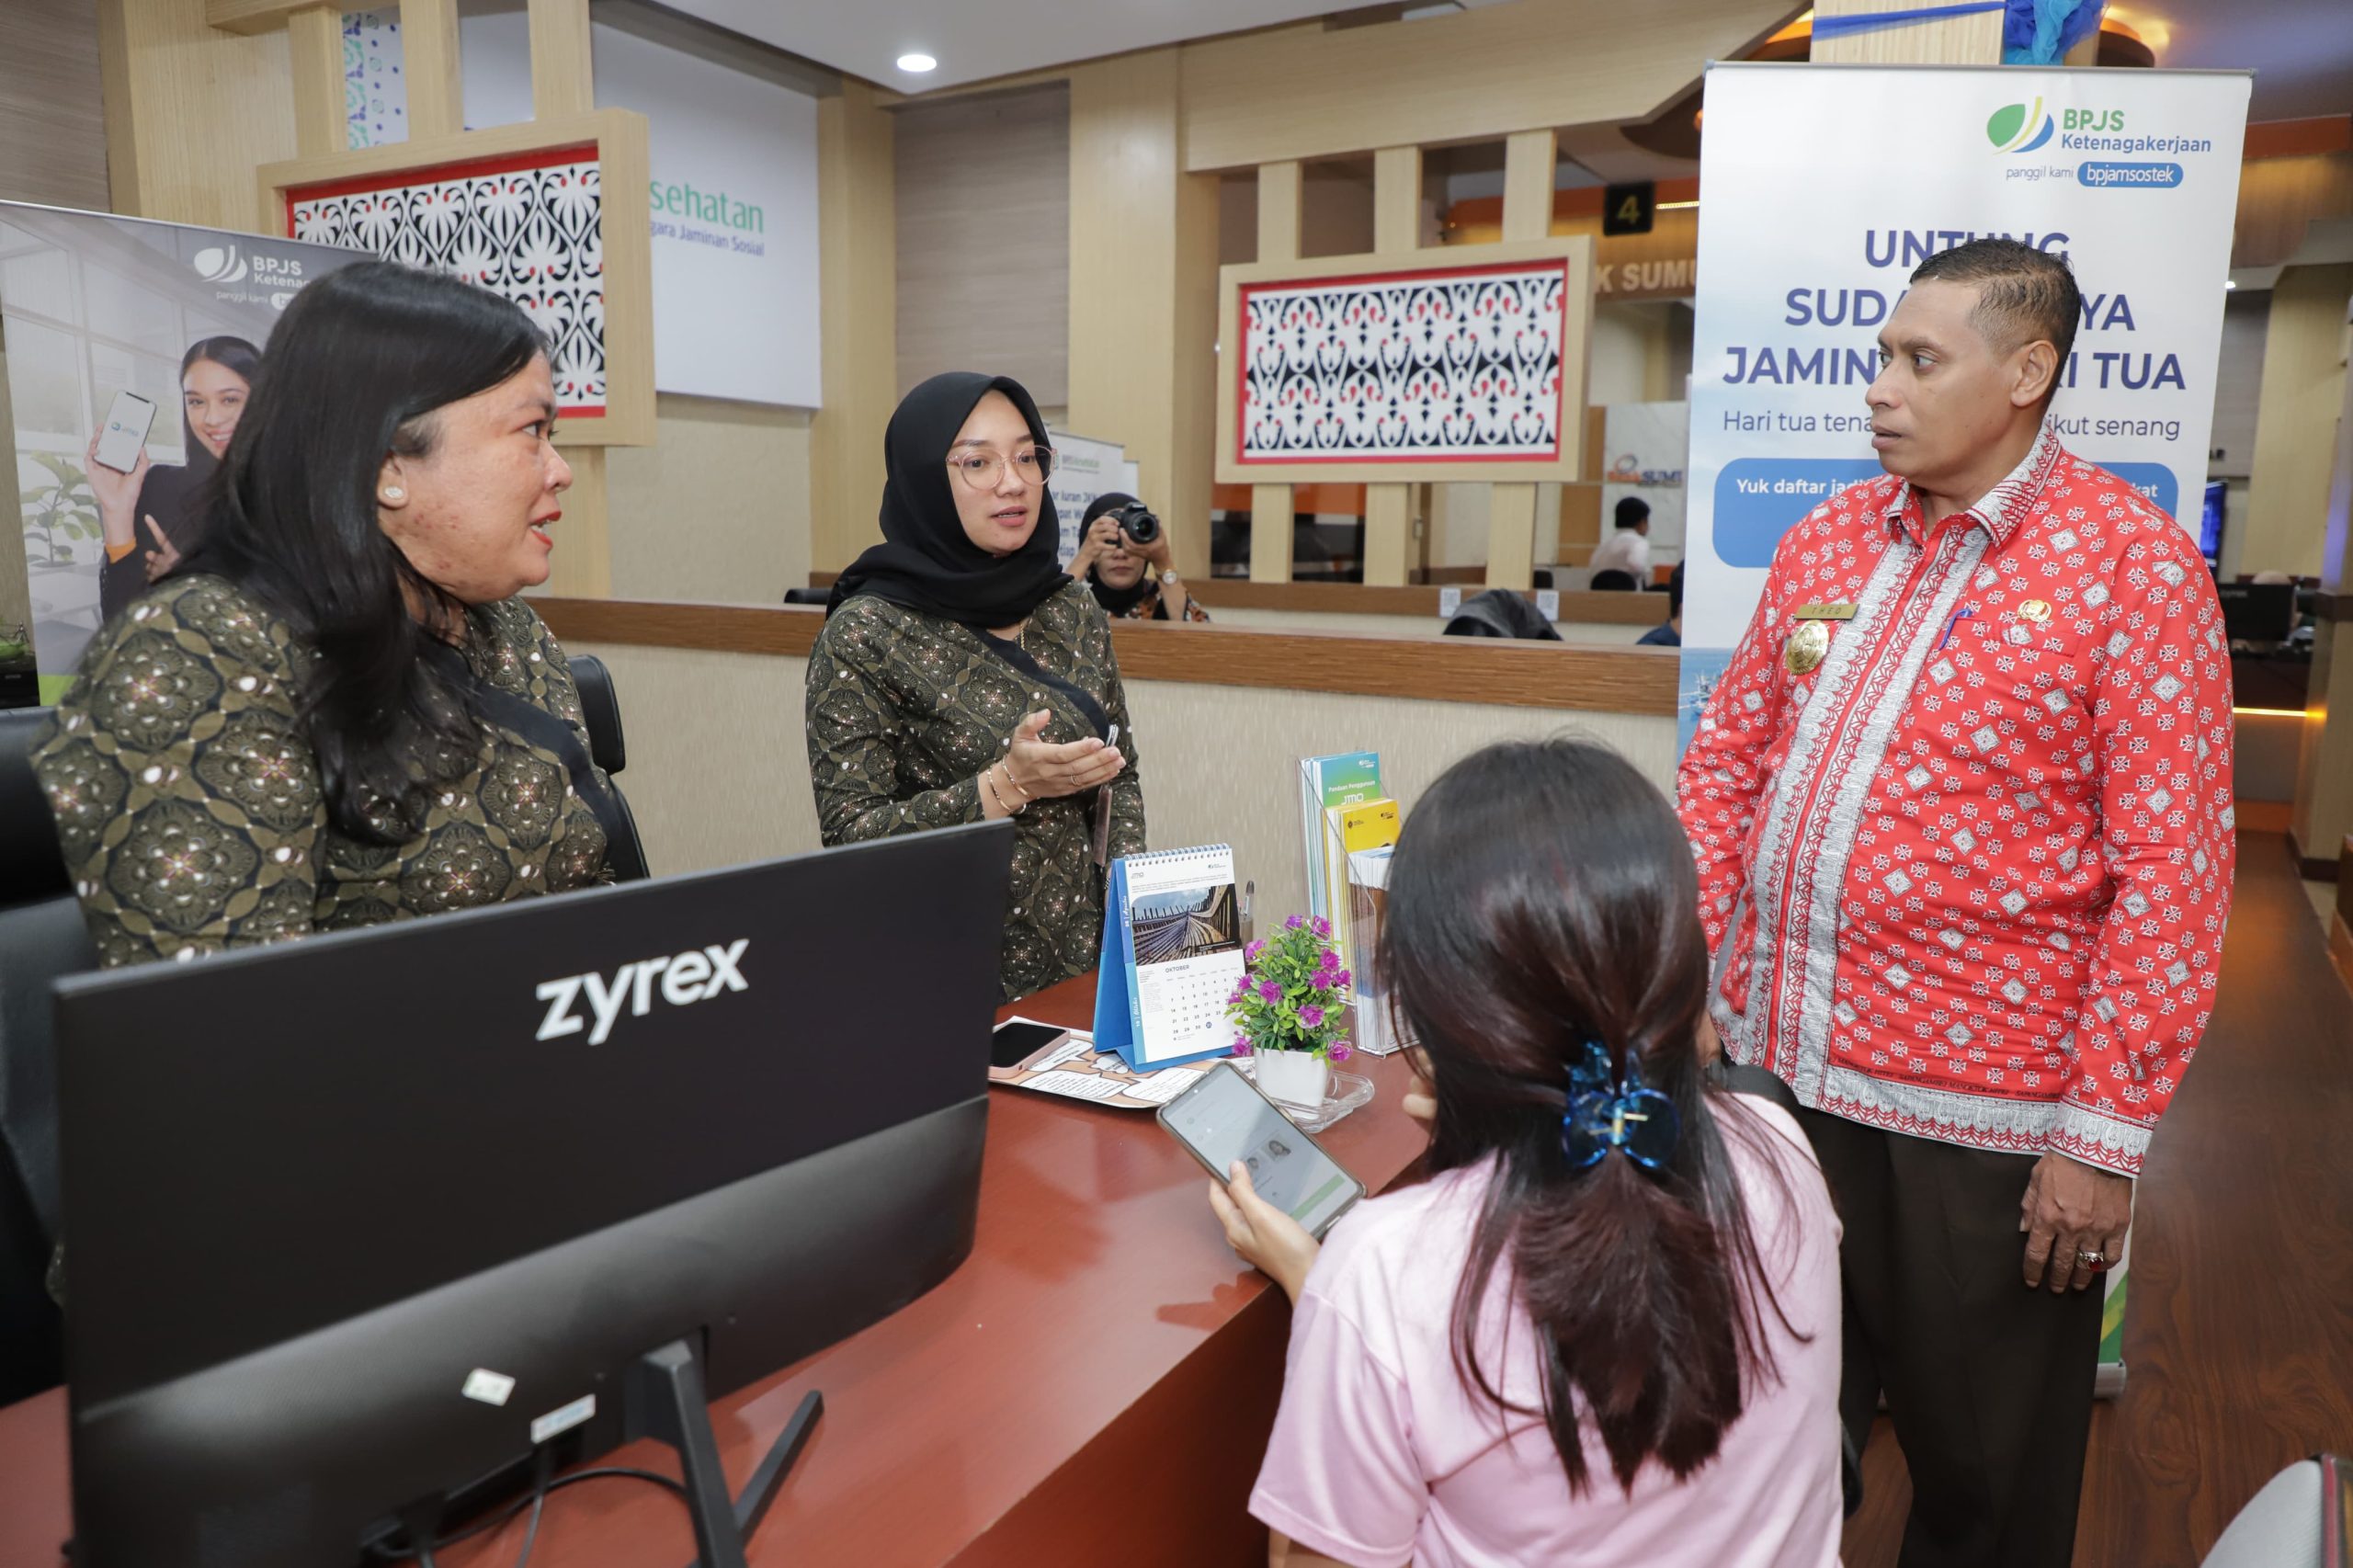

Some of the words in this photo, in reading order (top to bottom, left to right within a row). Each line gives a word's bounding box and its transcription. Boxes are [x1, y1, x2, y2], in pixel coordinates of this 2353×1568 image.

[2063, 108, 2125, 131] BPJS
[2062, 133, 2211, 154] Ketenagakerjaan
[2006, 165, 2047, 181] panggil
[2049, 166, 2074, 178] kami
[2086, 164, 2175, 186] bpjamsostek
[1616, 194, 1640, 225] 4
[679, 224, 729, 248] Jaminan
[731, 235, 765, 257] Sosial
[253, 255, 302, 276] BPJS
[1785, 288, 1907, 326] SUD
[2093, 352, 2187, 390] TUA
[1723, 410, 1771, 431] Hari
[1779, 414, 1816, 432] tua
[2096, 419, 2181, 442] senang
[1736, 478, 1769, 494] Yuk
[1774, 478, 1826, 494] daftar
[1165, 964, 1190, 973] OKTOBER
[535, 938, 750, 1046] zyrex
